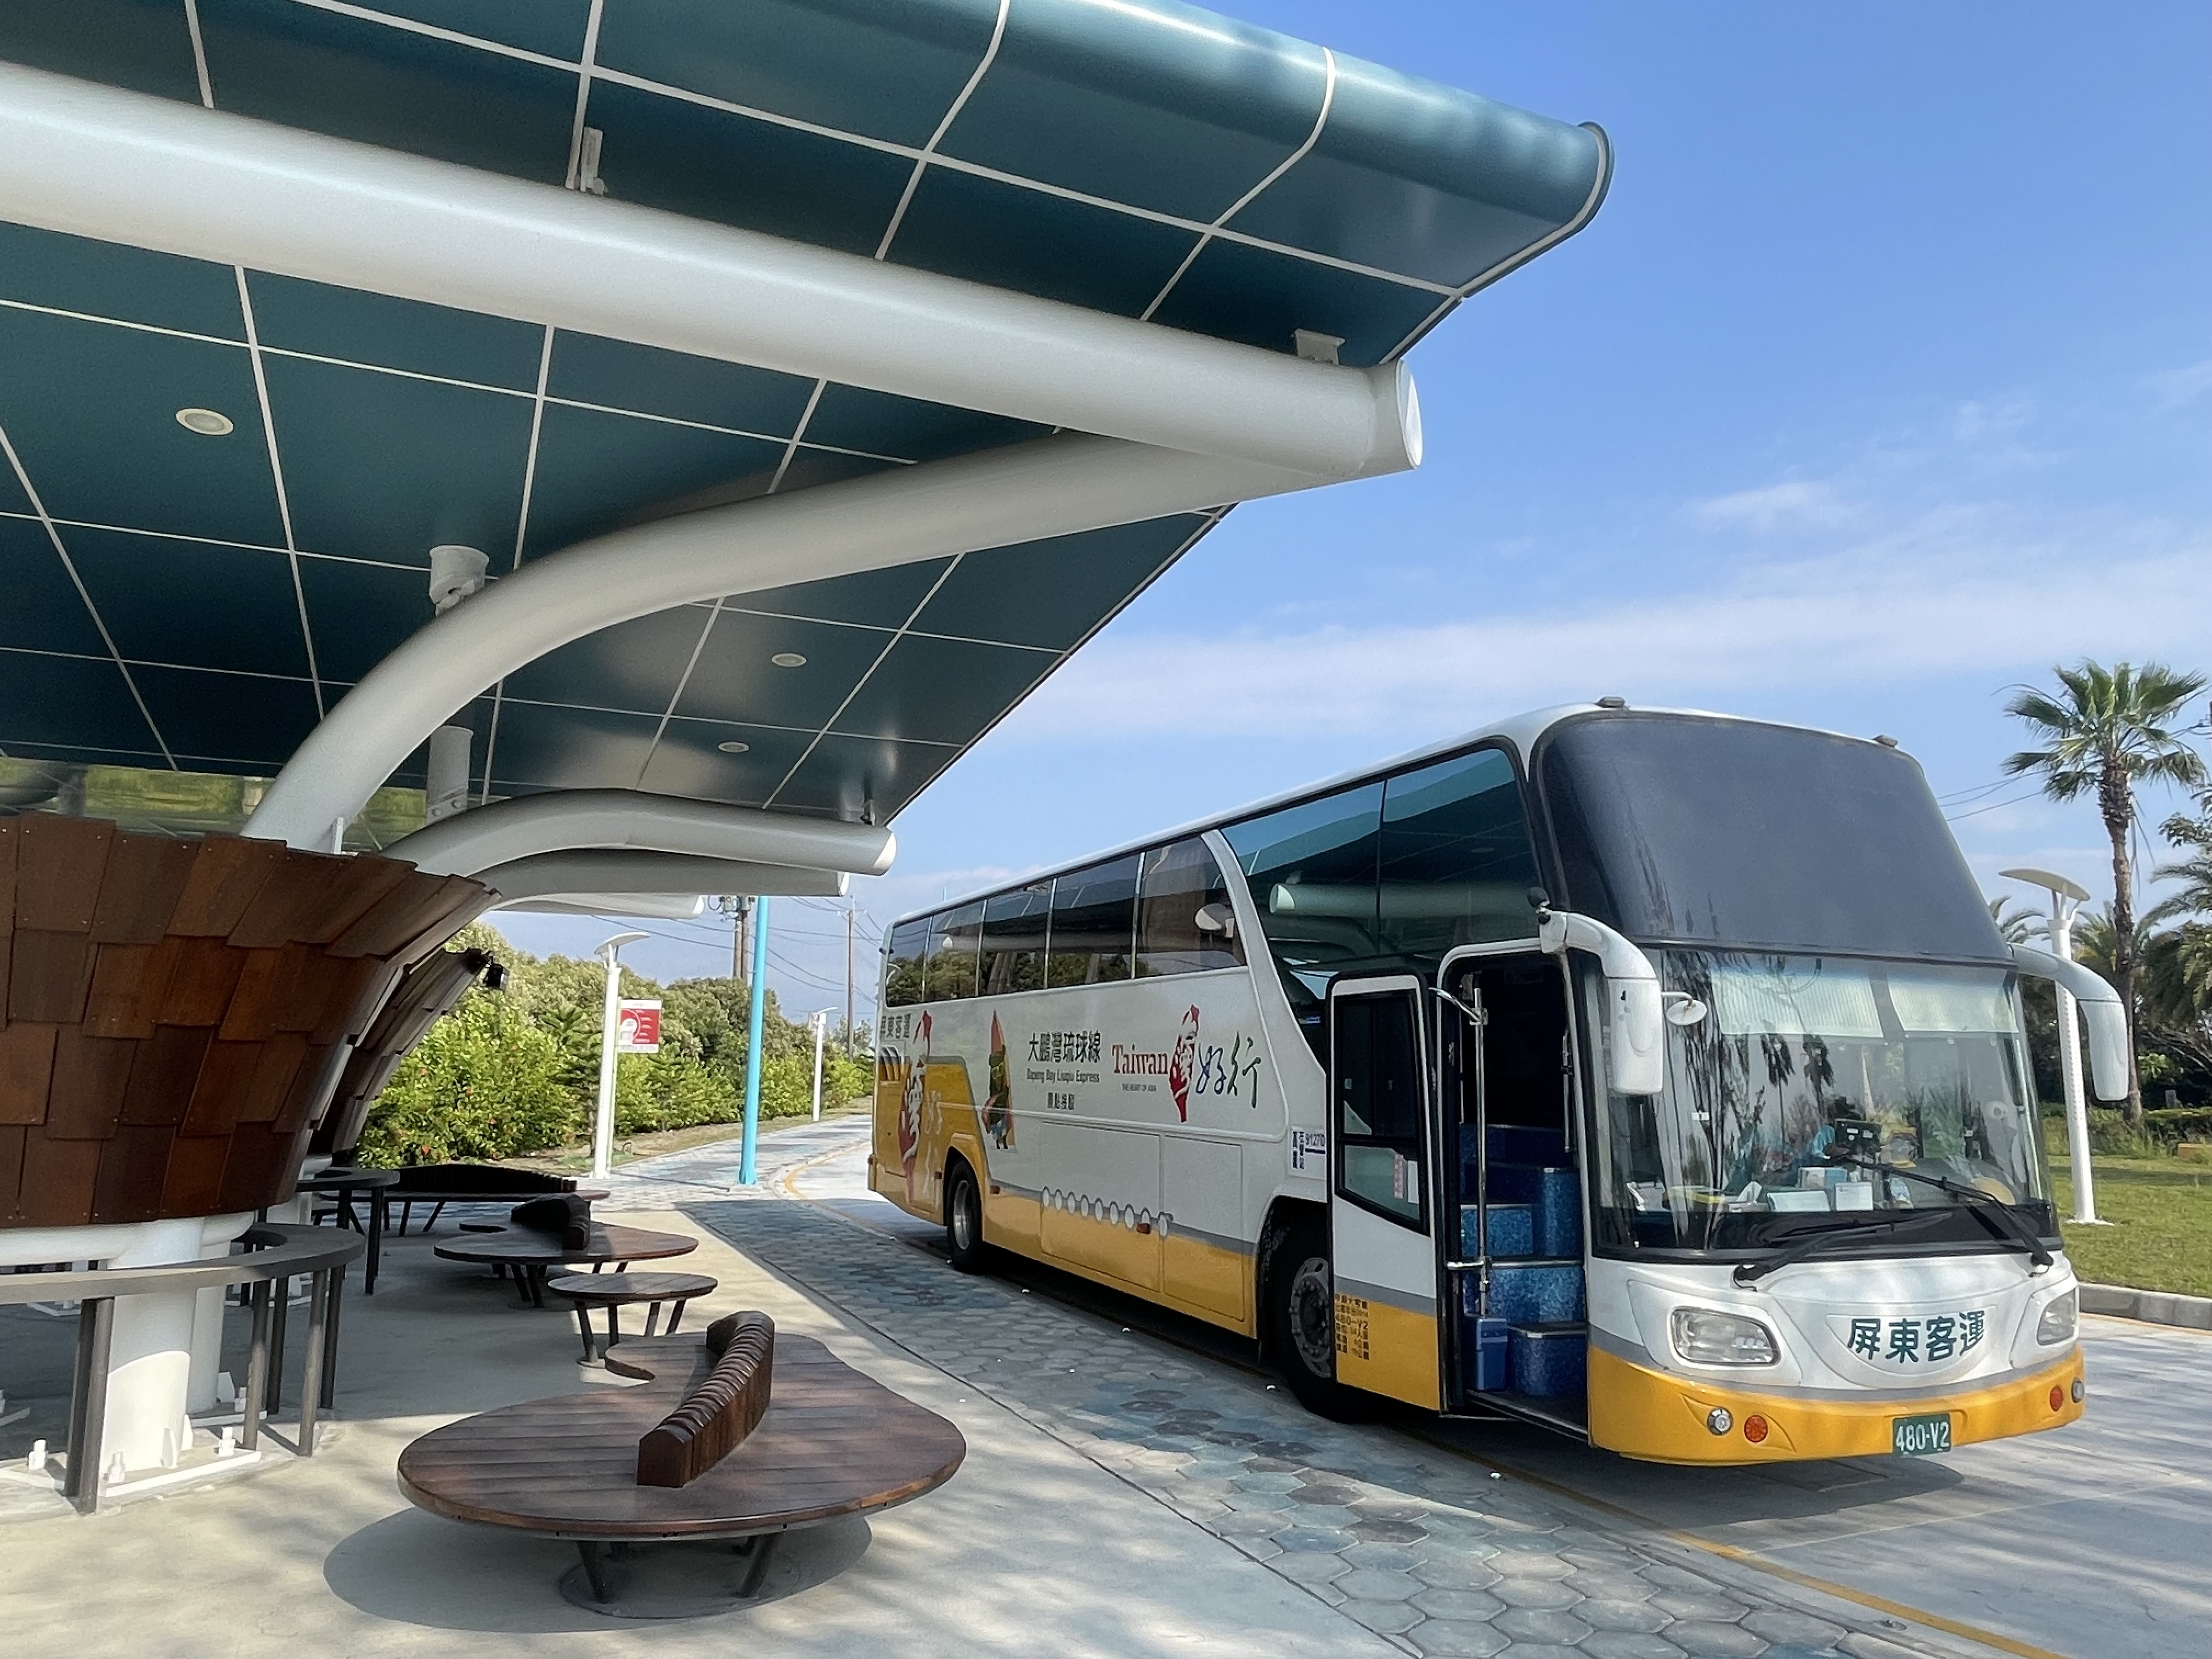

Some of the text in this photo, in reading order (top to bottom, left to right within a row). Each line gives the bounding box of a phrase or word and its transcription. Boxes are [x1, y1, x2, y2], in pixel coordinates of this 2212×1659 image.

[1027, 1029, 1101, 1063] 大鵬灣琉球線
[1111, 1043, 1169, 1074] Taiwan
[1847, 1311, 1984, 1363] 屏東客運
